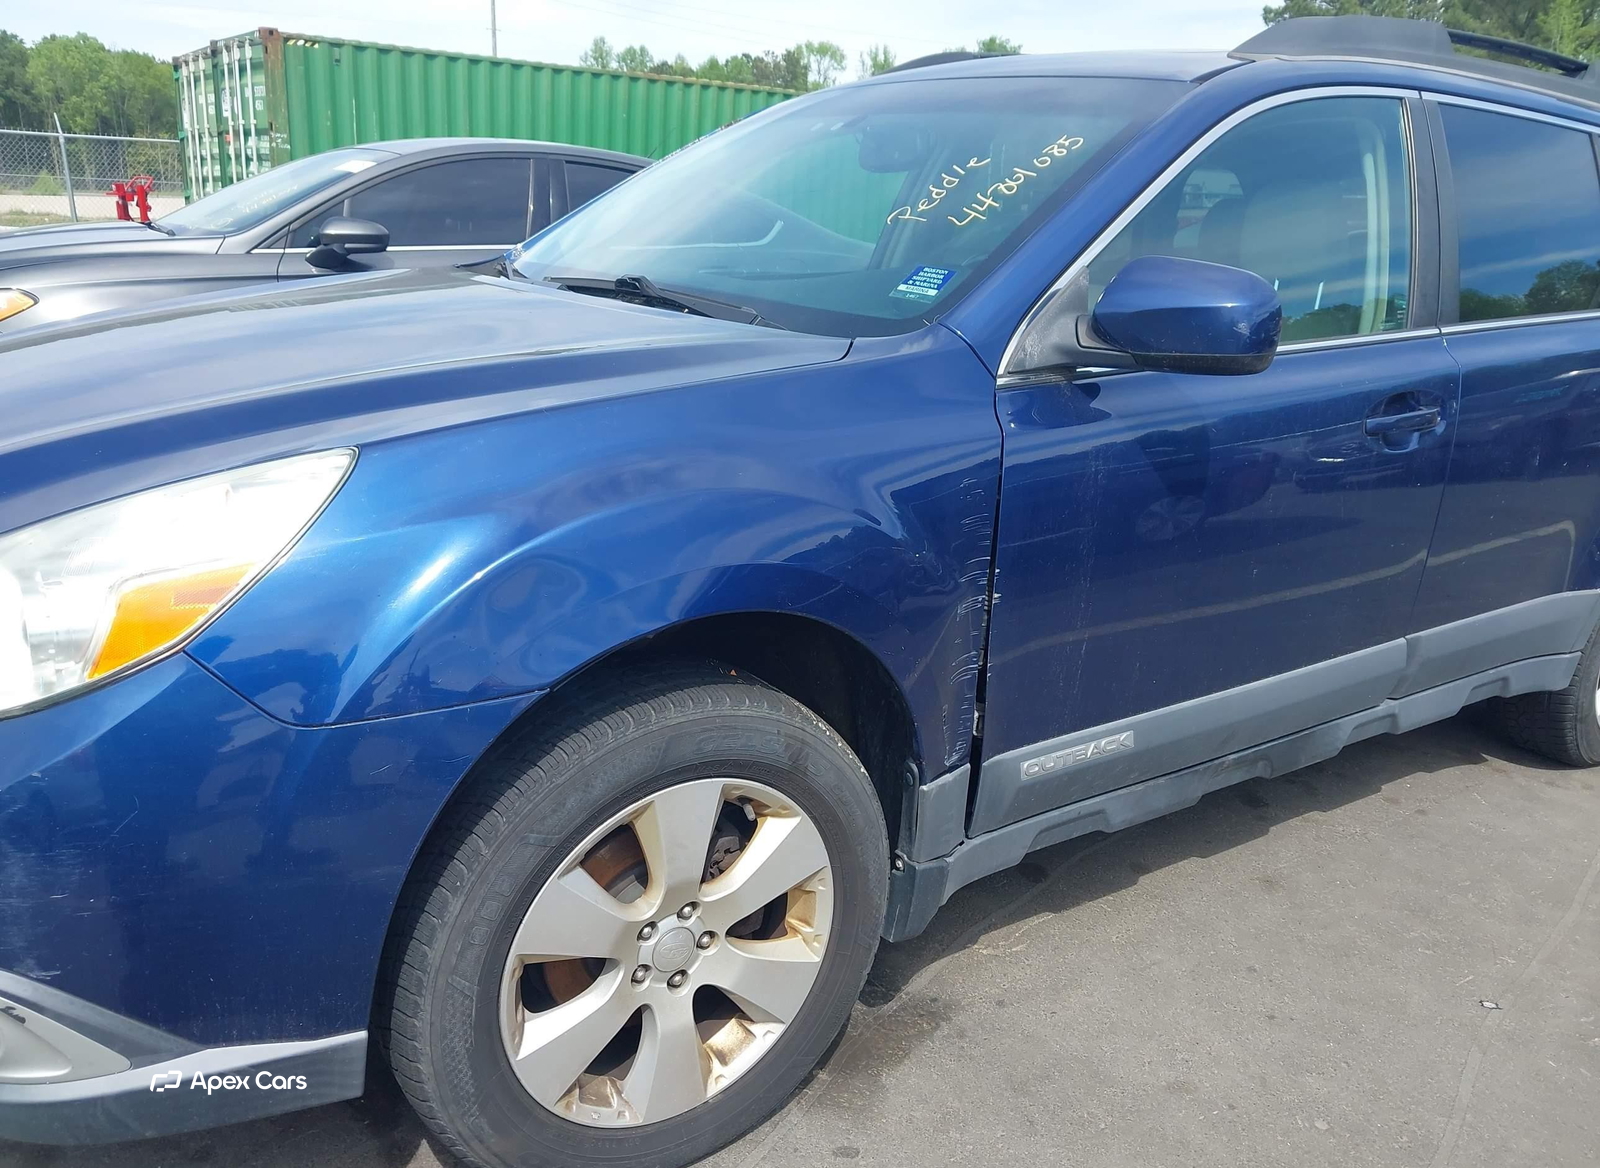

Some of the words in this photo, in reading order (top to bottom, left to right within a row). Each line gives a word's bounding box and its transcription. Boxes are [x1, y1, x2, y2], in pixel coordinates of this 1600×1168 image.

[887, 156, 991, 225] Peddle
[912, 276, 942, 284] SHIPYARD
[914, 280, 938, 289] MARINA
[1022, 731, 1132, 778] OUTBACK
